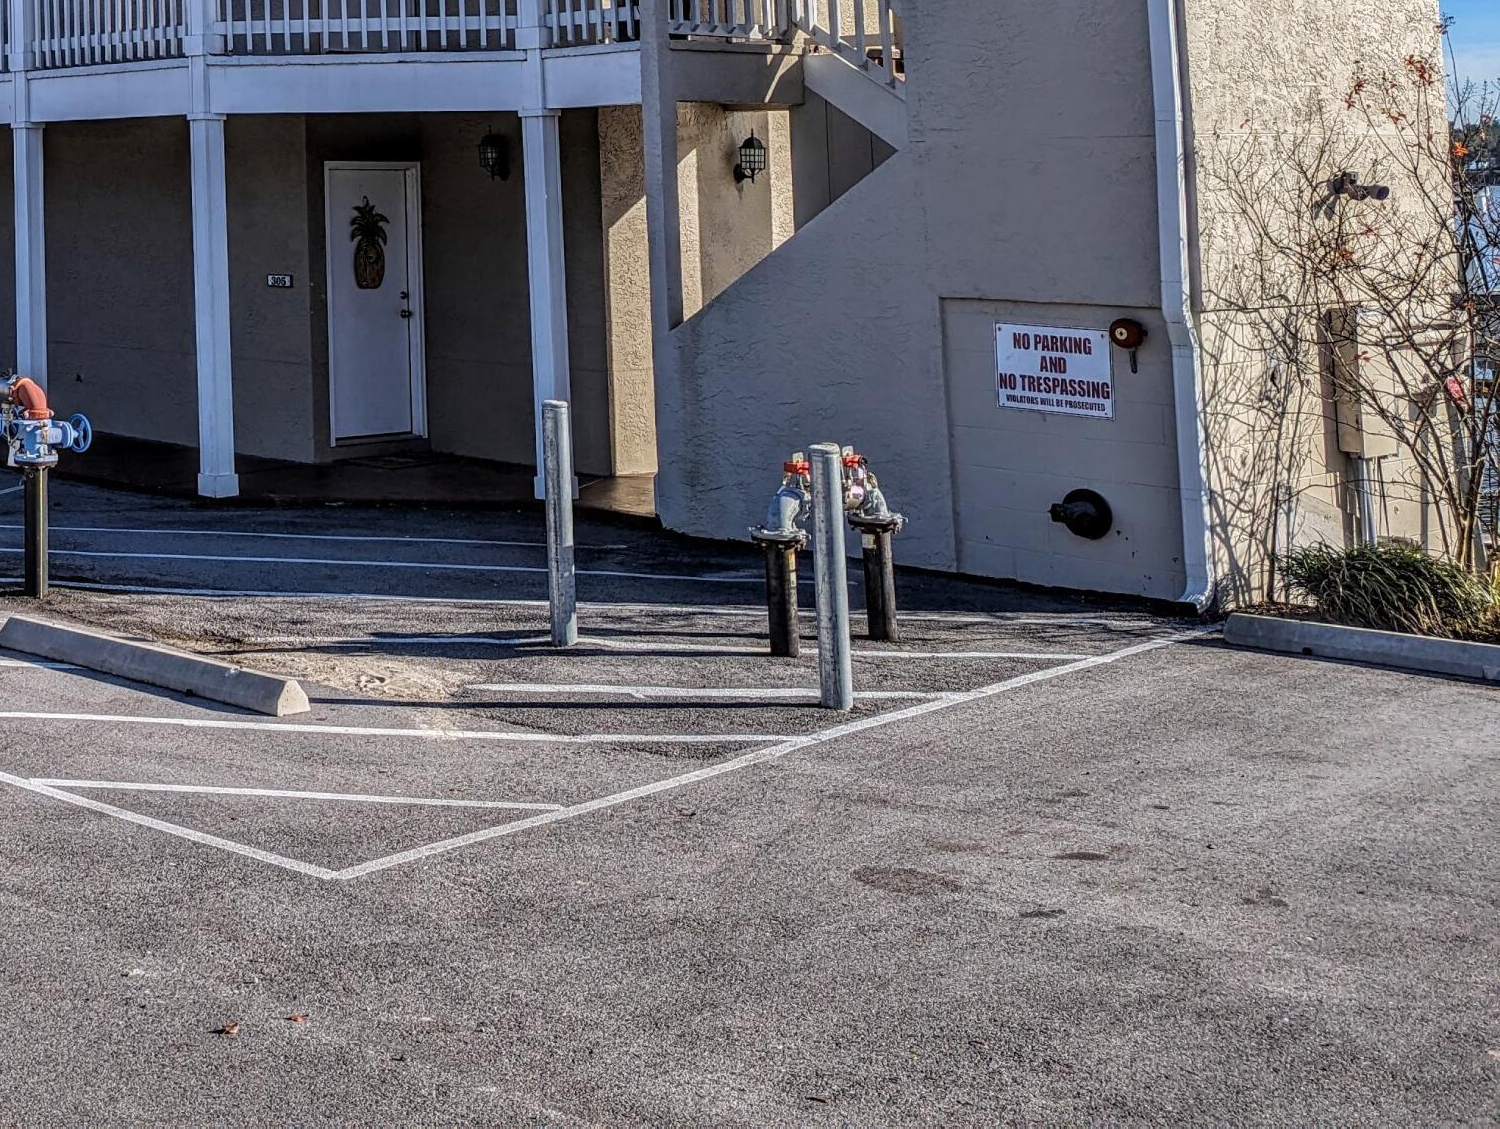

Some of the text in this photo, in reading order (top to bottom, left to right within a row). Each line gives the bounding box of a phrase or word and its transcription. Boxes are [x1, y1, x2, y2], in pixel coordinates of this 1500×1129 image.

[270, 276, 286, 286] 305
[1013, 332, 1092, 355] NO PARKING
[1040, 356, 1067, 374] AND
[999, 372, 1111, 400] NO TRESPASSING
[1006, 394, 1106, 412] VIOLATORS WILL BE PROSECUTED
